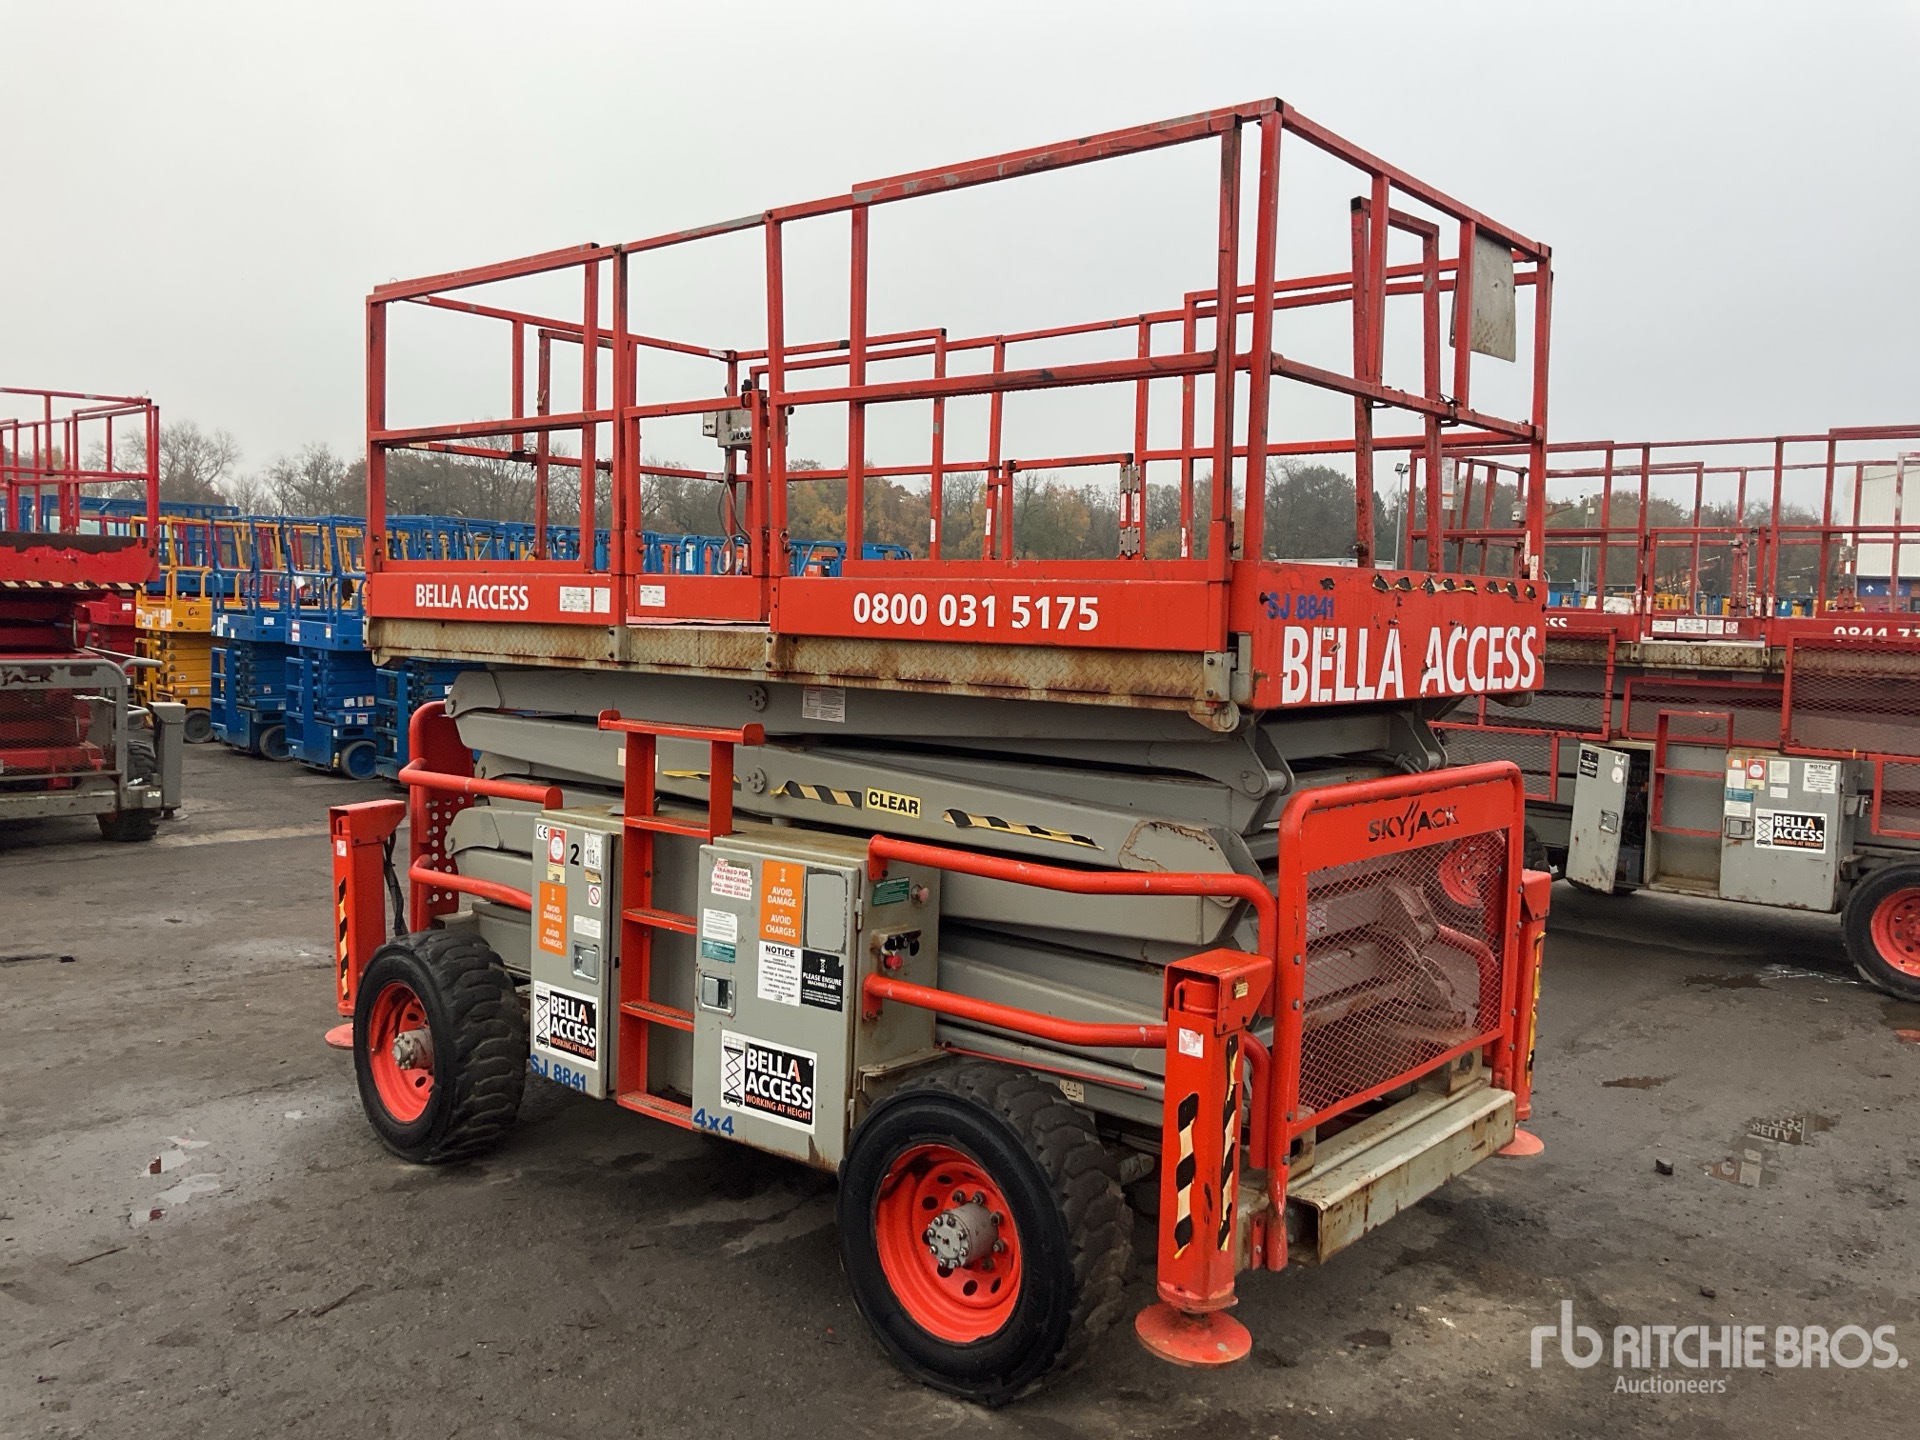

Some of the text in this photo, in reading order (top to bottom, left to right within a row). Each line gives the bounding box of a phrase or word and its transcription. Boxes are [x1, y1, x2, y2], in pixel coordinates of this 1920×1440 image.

[415, 584, 529, 611] BELLA ACCESS
[1267, 592, 1334, 620] SJ 8841
[853, 592, 1099, 631] 0800 031 5175
[1545, 618, 1568, 628] SS
[1281, 626, 1537, 704] BELLA ACCESS
[868, 791, 918, 814] CLEAR
[1368, 799, 1460, 842] SKYJACK
[1774, 815, 1816, 830] BELLA
[1774, 828, 1824, 842] ACCESS
[570, 844, 579, 866] 2
[716, 867, 737, 875] TRAINED
[767, 895, 796, 908] DAMAGE
[772, 886, 793, 897] AVOID
[766, 924, 796, 937] CHARGES
[770, 914, 792, 925] AVOID
[765, 945, 795, 958] NOTICE
[803, 972, 842, 986] PLEASE ENSURE
[550, 995, 588, 1024] BELLA
[550, 1016, 596, 1048] ACCESS
[551, 1036, 595, 1058] WORKING AT HEIGHT
[530, 1054, 586, 1093] SJ 8841
[746, 1048, 800, 1082] BELLA
[746, 1071, 812, 1110] ACCESS
[745, 1094, 811, 1120] WORKING AT HEIGHT
[694, 1107, 734, 1136] 4x4
